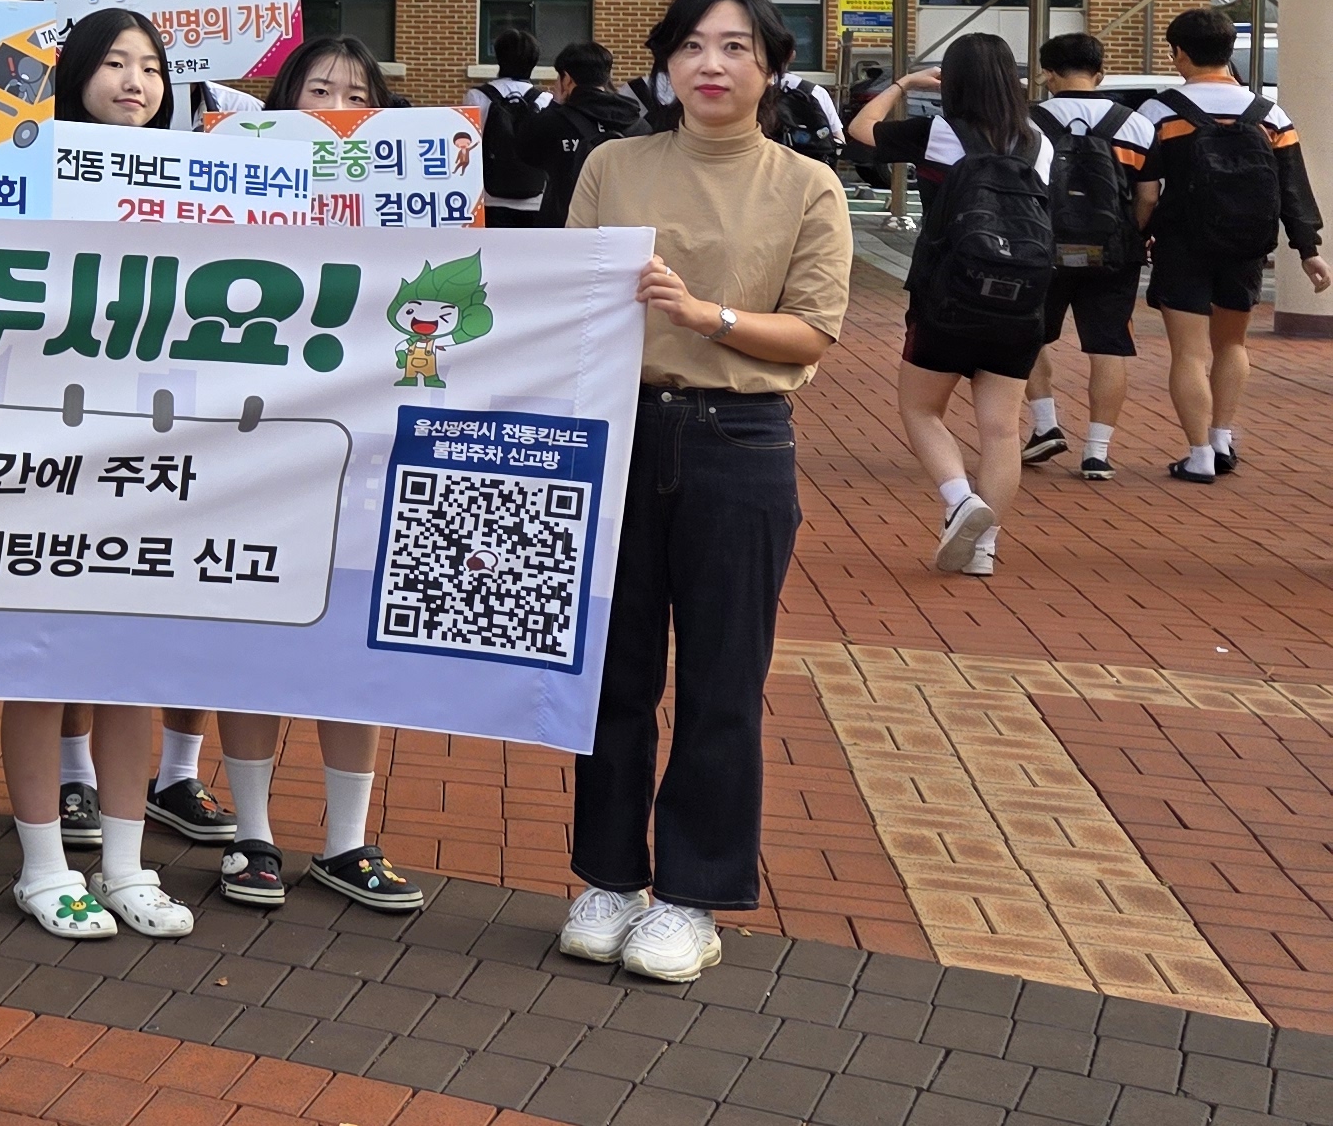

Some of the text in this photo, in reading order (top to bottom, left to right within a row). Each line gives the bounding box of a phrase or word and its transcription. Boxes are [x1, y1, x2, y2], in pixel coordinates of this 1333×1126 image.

[40, 28, 57, 44] TA
[151, 2, 292, 47] 생명의 가치
[166, 59, 210, 73] 고등학교
[56, 148, 309, 199] 전동 킥보드 면허 필수!!
[312, 138, 448, 178] 존중의 길
[375, 191, 473, 228] 걸어요
[414, 418, 589, 448] 울산광역시 전동킥보드
[432, 440, 561, 470] 불법주차 신고방
[97, 453, 197, 501] 주차
[193, 537, 281, 584] 신고
